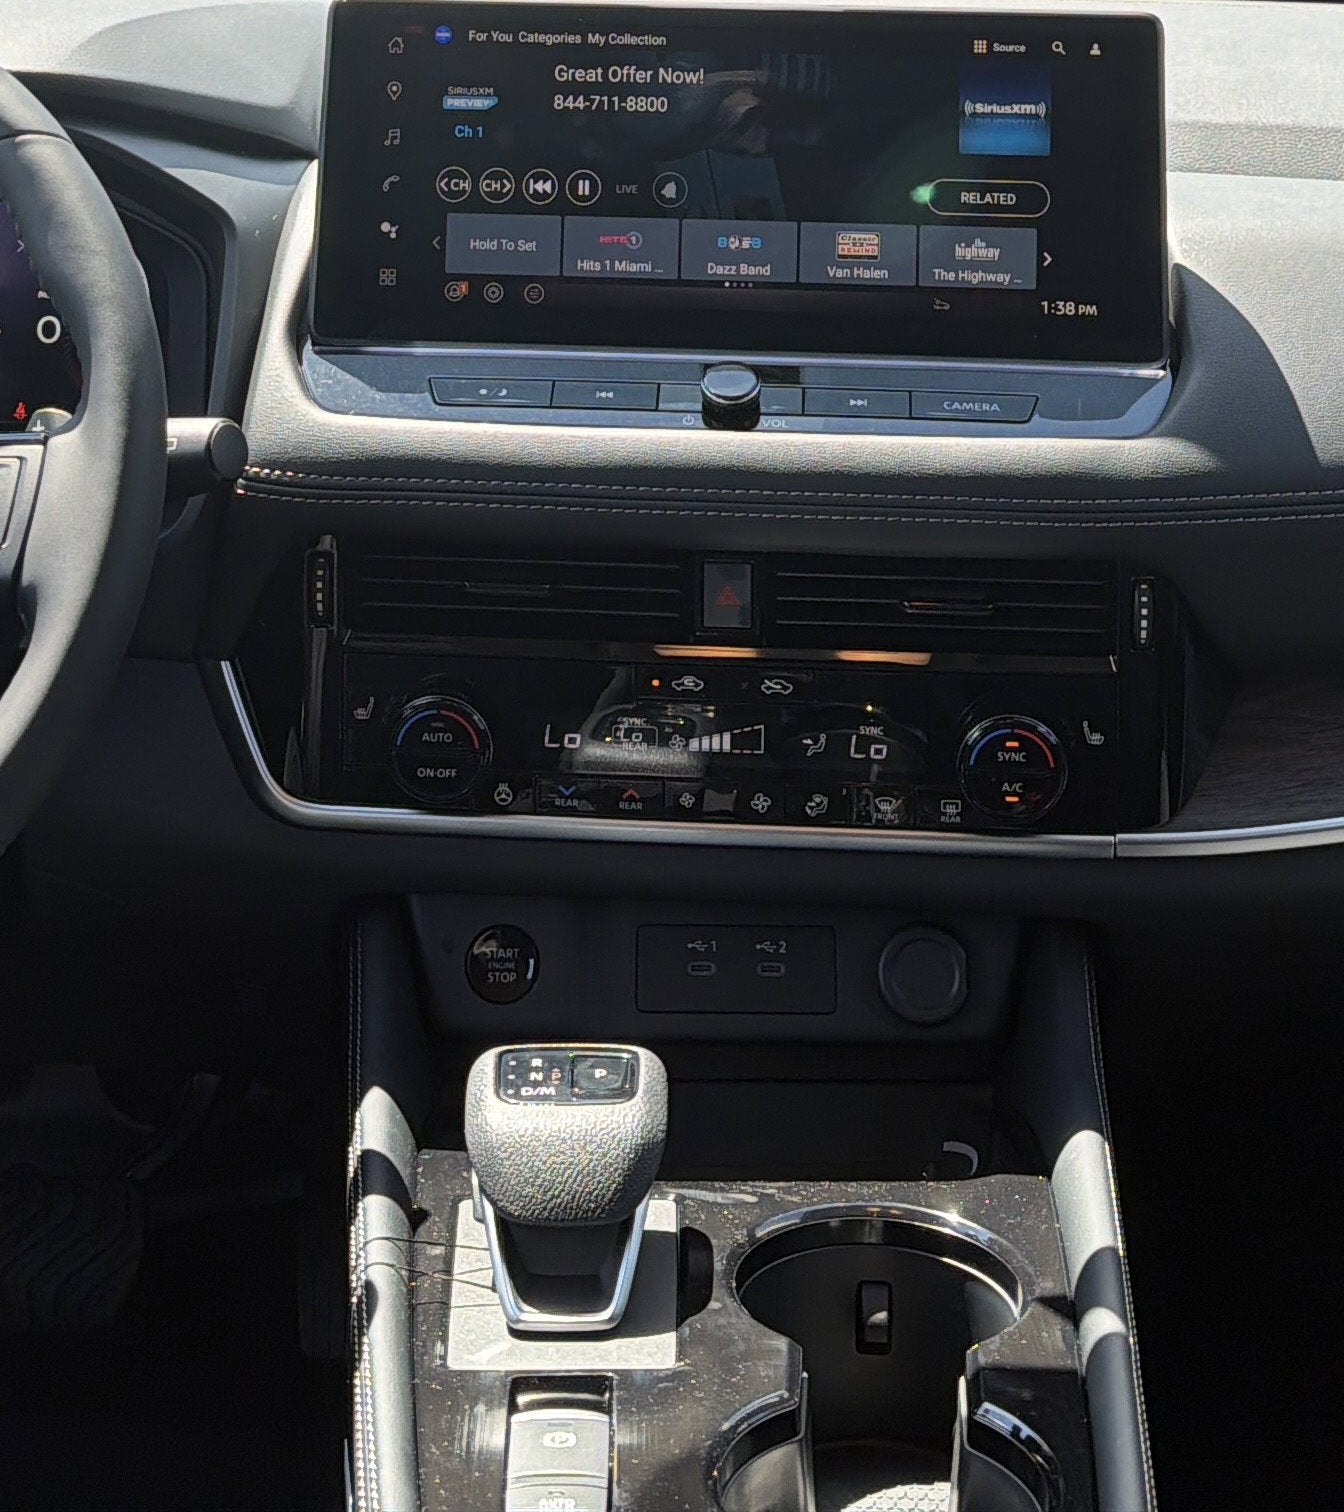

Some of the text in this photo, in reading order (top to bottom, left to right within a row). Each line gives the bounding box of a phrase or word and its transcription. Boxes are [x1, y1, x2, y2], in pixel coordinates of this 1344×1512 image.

[469, 31, 667, 47] For You Categories My Collection
[992, 43, 1026, 53] Source
[555, 65, 704, 84] Great Offer Now!
[447, 86, 494, 96] SIRIUSXM
[447, 98, 491, 108] PREVIEW
[553, 95, 668, 113] 844-711-8800
[454, 125, 484, 138] Ch 1
[450, 179, 469, 191] CH
[482, 180, 501, 192] CH
[616, 184, 639, 194] LIVE
[960, 192, 1016, 205] RELATED
[470, 238, 537, 252] Hold To Set
[955, 243, 1000, 261] highway
[577, 259, 652, 273] Hits 1 Miami
[707, 263, 771, 276] Dazz Band
[828, 266, 889, 279] Van Halen
[933, 269, 1011, 286] The Highway
[1041, 301, 1098, 316] 1:38 PM
[943, 400, 1001, 412] CAMERA
[762, 418, 789, 428] VOL
[624, 717, 647, 726] SYNC
[859, 726, 884, 735] SYNC
[422, 732, 453, 742] AUTO
[622, 742, 647, 751] REAR
[997, 752, 1027, 763] SYNC
[1002, 782, 1023, 792] A/C
[555, 799, 578, 807] REAR
[619, 802, 643, 810] REAR
[940, 815, 961, 823] REAR
[710, 941, 716, 952] 1
[779, 941, 787, 953] 2
[486, 948, 520, 959] START
[487, 972, 516, 983] STOP
[531, 1058, 543, 1067] R
[530, 1072, 544, 1081] N
[594, 1068, 608, 1079] P
[520, 1086, 556, 1096] D/M
